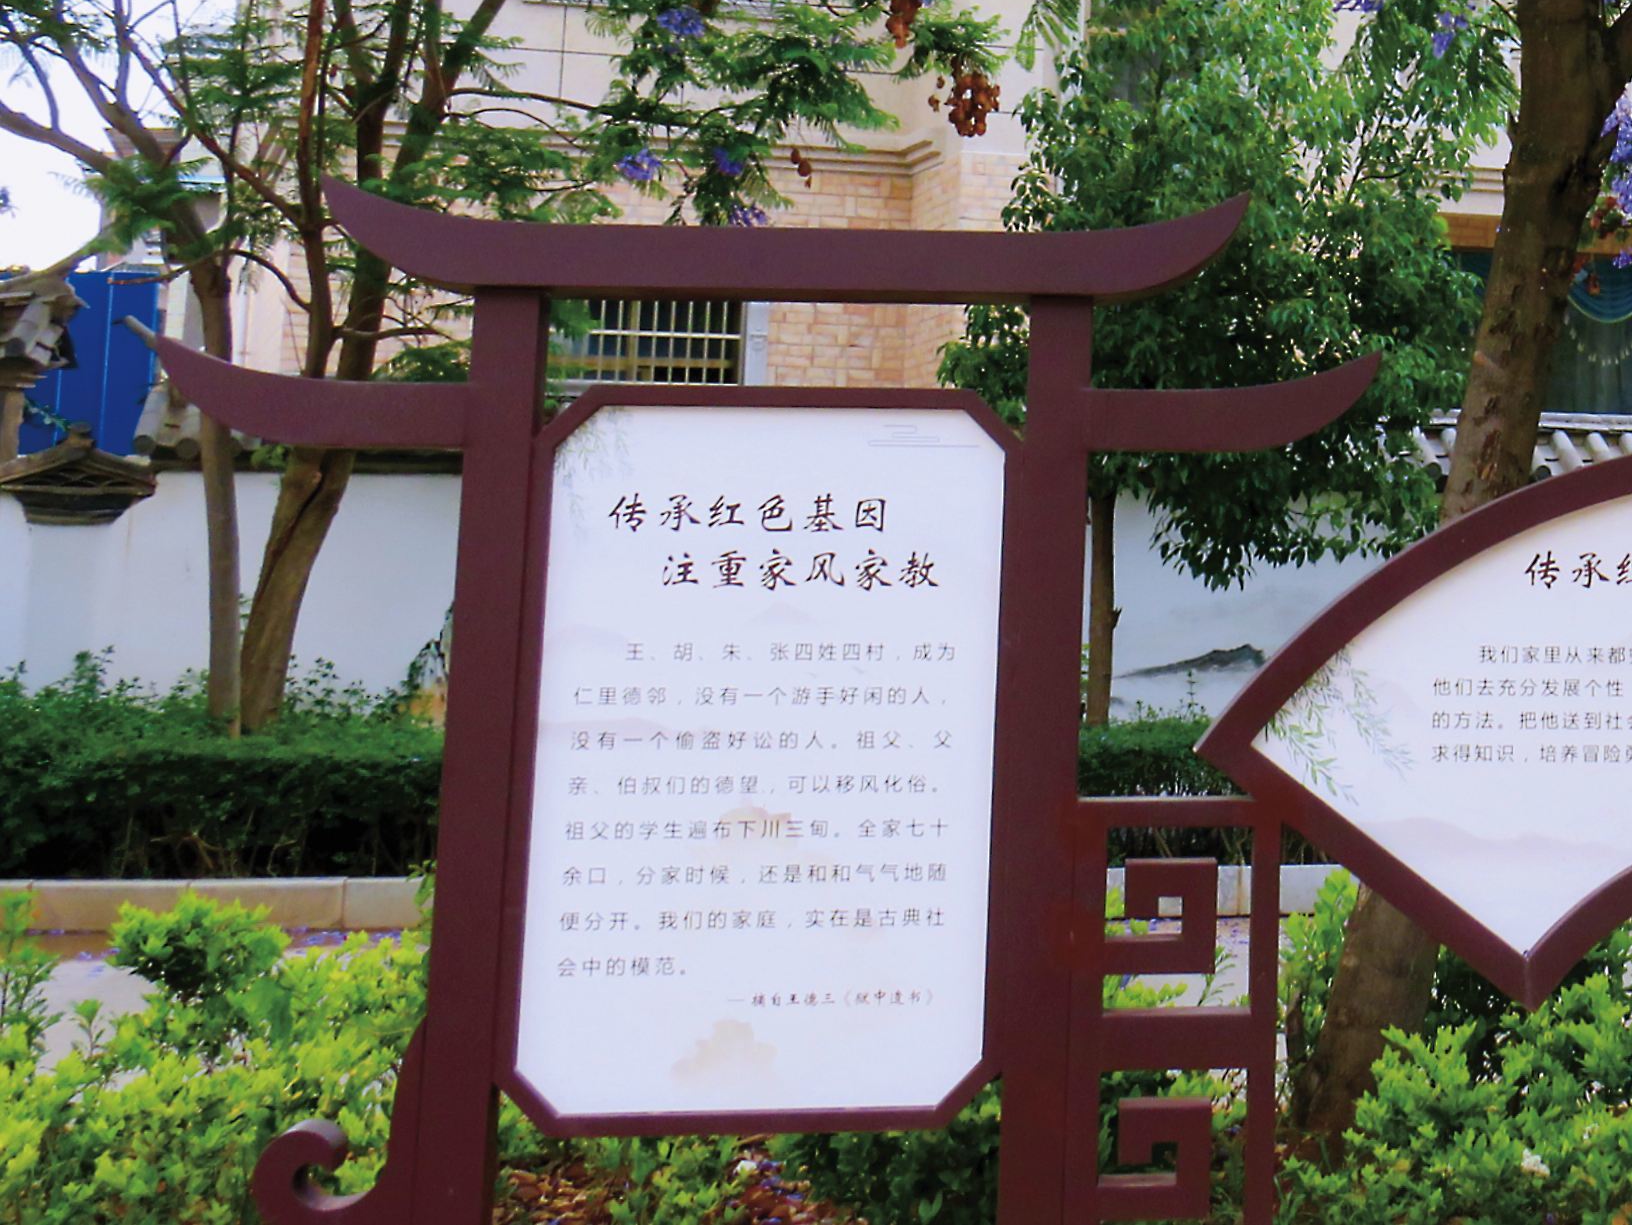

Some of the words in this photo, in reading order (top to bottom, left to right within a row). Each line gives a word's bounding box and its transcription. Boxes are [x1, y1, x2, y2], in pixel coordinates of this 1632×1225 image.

[608, 492, 888, 534] 传承红色基因
[661, 548, 940, 592] 注重家风家教
[557, 956, 688, 977] 会中的模范。
